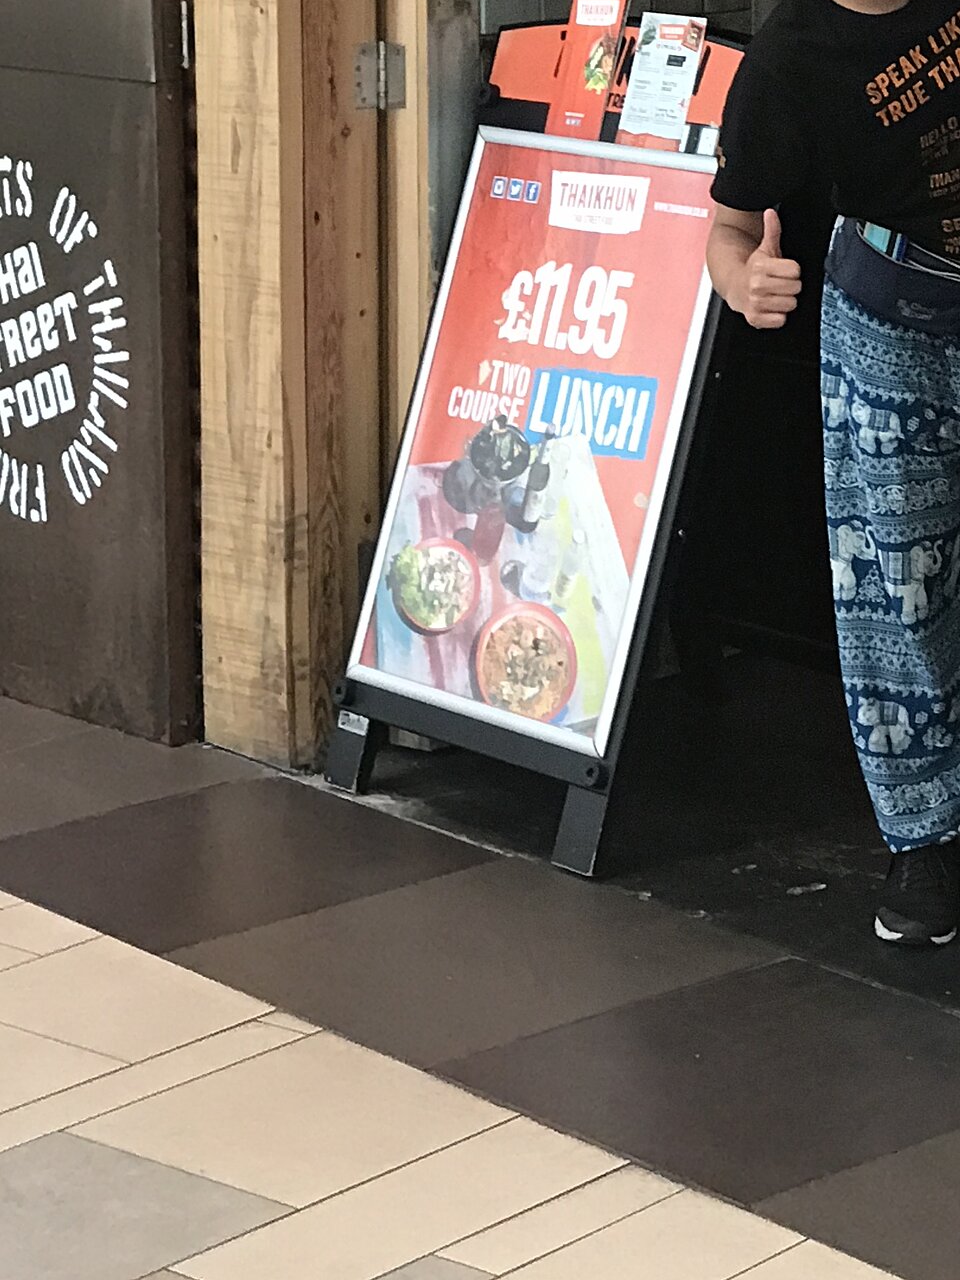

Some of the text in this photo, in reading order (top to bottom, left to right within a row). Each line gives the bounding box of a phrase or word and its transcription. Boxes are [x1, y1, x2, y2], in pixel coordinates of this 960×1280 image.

[866, 45, 928, 105] SPEAK
[875, 81, 931, 127] TRUE
[49, 186, 98, 254] OF
[560, 182, 637, 212] THAIKHUN
[498, 260, 635, 359] £11.95
[0, 363, 76, 438] FOOD
[448, 386, 525, 428] COURSE
[490, 359, 531, 397] TWO
[529, 372, 650, 453] LUNCH
